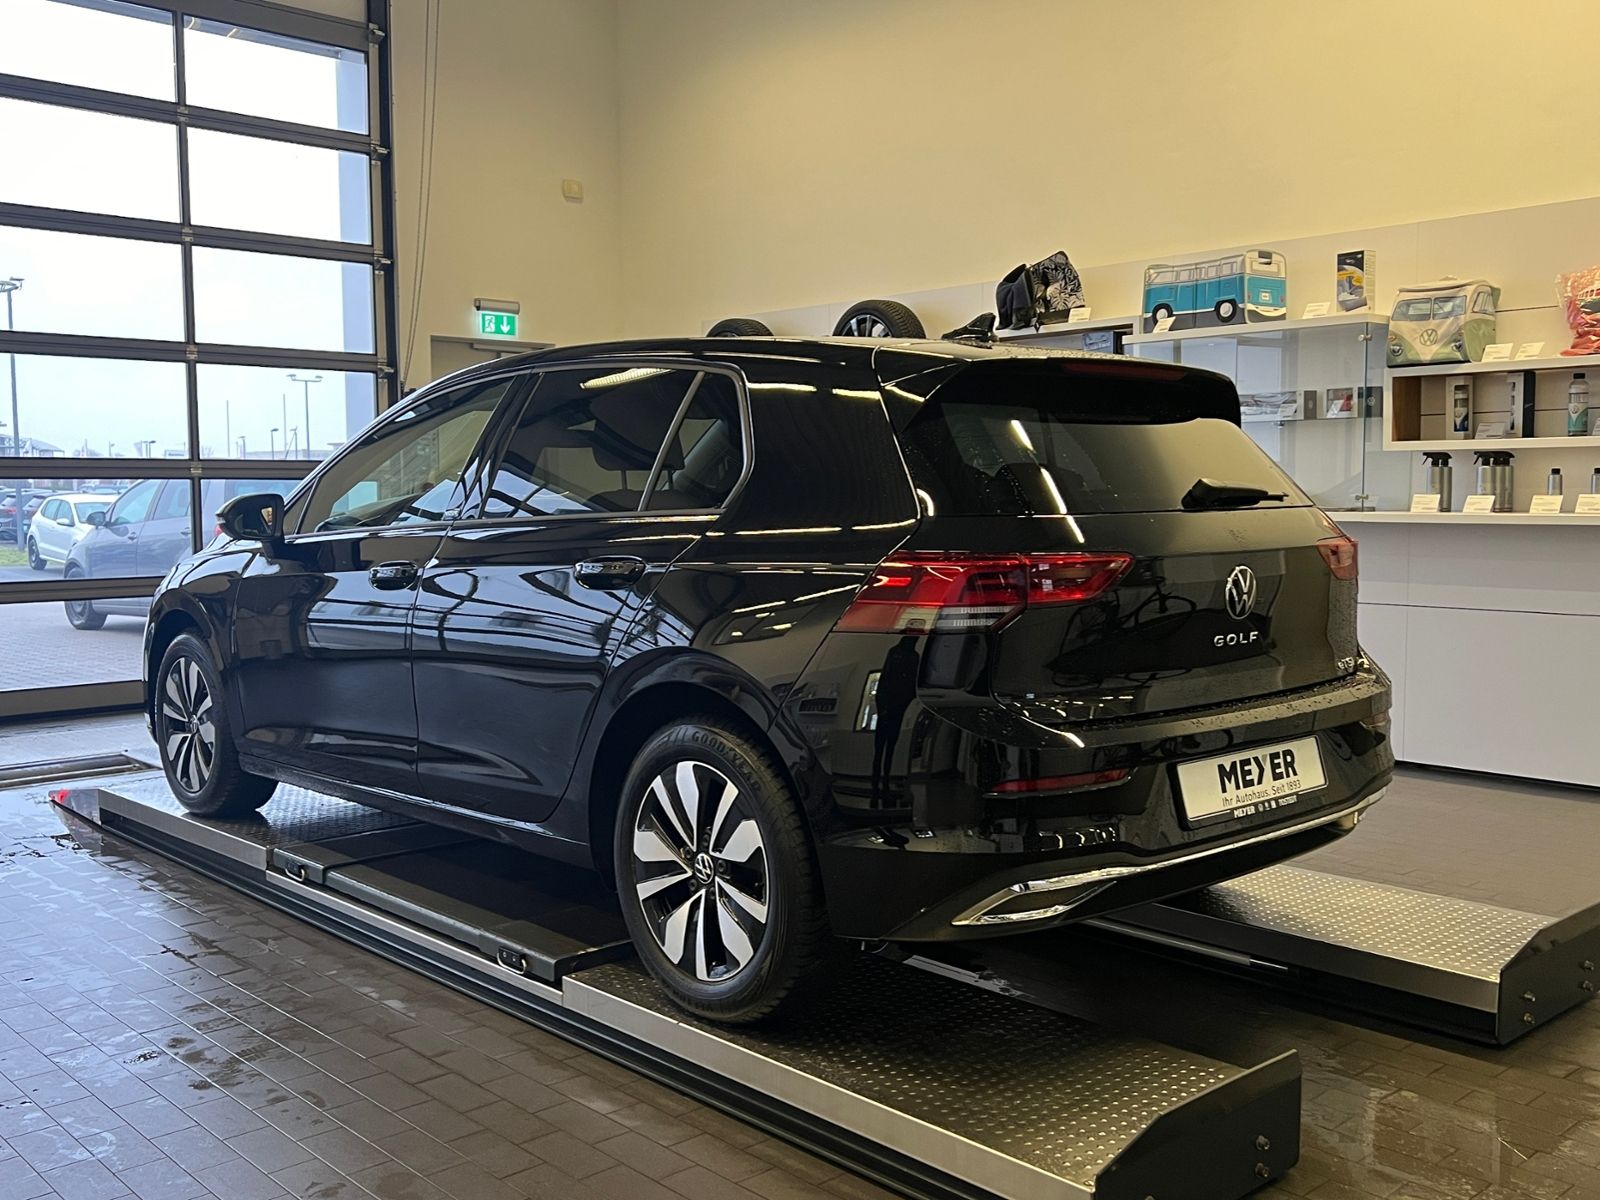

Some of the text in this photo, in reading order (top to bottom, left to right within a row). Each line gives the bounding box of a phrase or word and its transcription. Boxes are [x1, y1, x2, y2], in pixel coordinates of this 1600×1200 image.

[1214, 631, 1259, 647] GOLF
[1217, 748, 1298, 794] MEYER
[1222, 797, 1233, 807] Ihr
[1272, 786, 1285, 796] Seit
[1286, 780, 1301, 790] 1893
